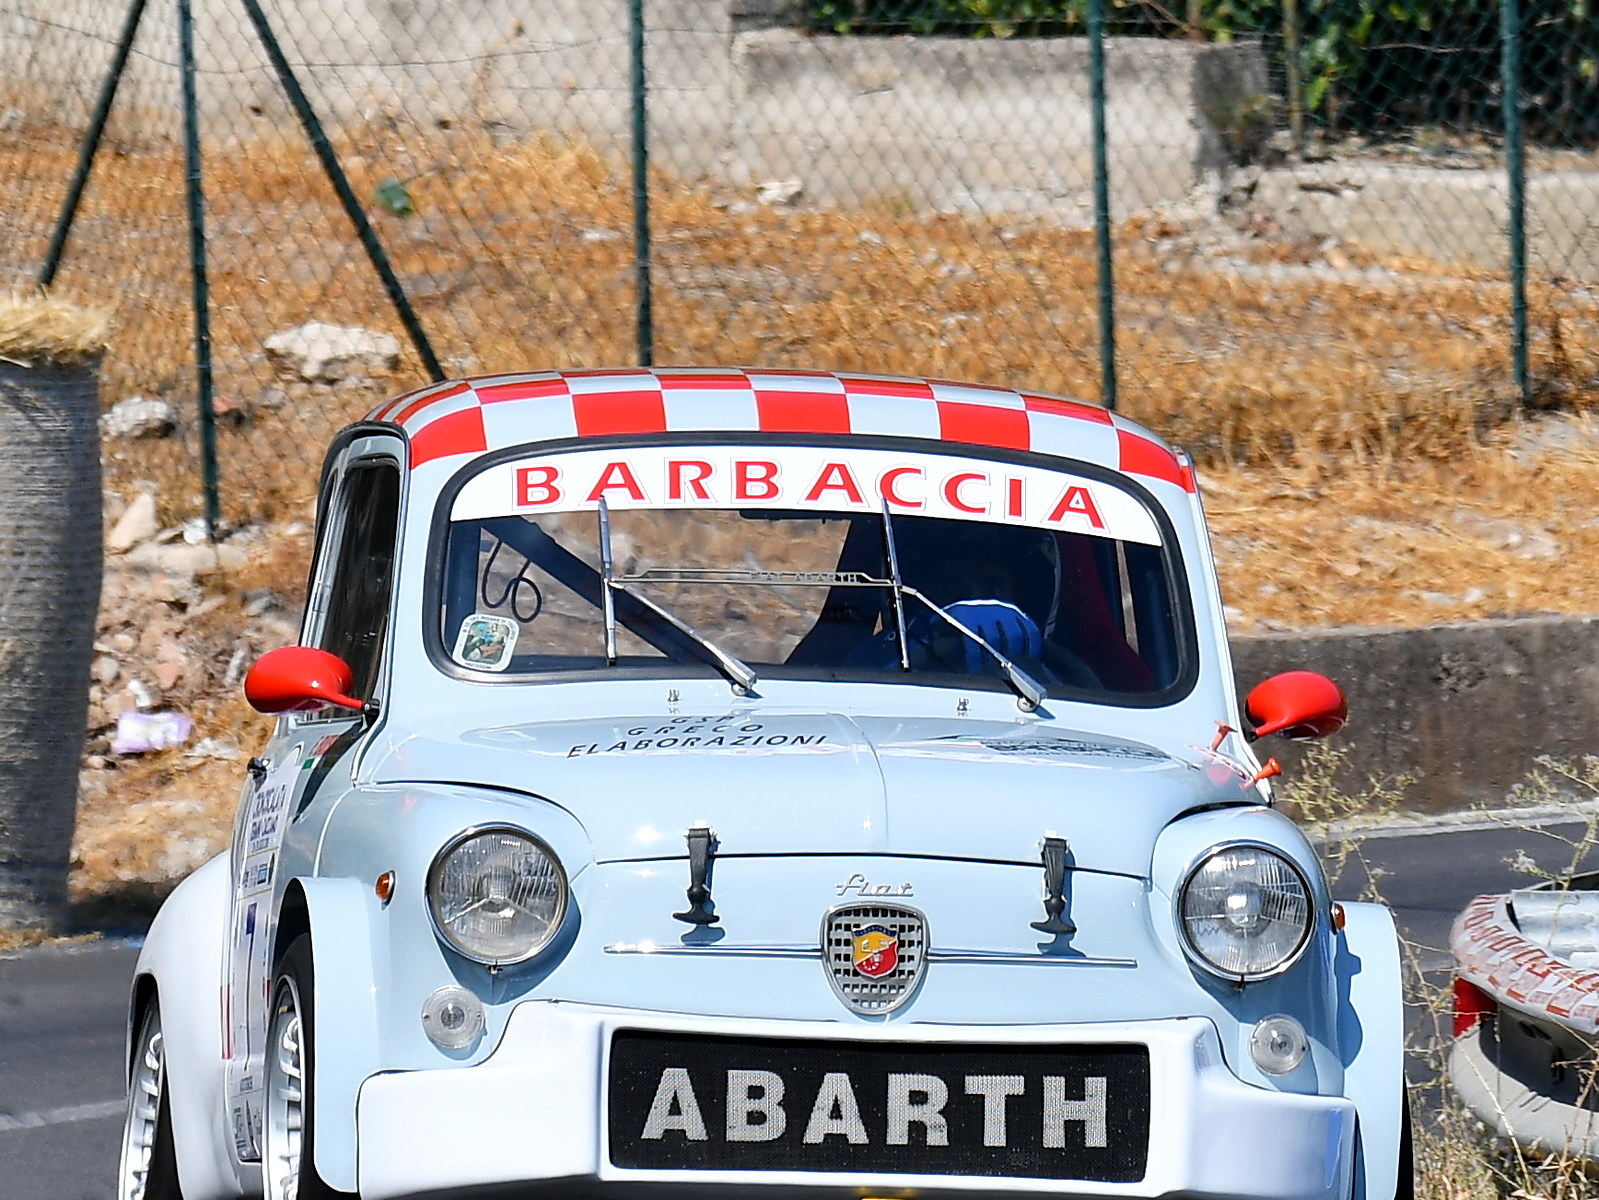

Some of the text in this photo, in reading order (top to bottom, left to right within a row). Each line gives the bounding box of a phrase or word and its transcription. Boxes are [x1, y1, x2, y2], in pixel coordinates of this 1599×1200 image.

[512, 457, 1110, 533] BARBACCIA
[566, 734, 827, 759] ELABORAZIONI
[627, 724, 763, 736] GRECO
[640, 1067, 1107, 1149] ABARTH
